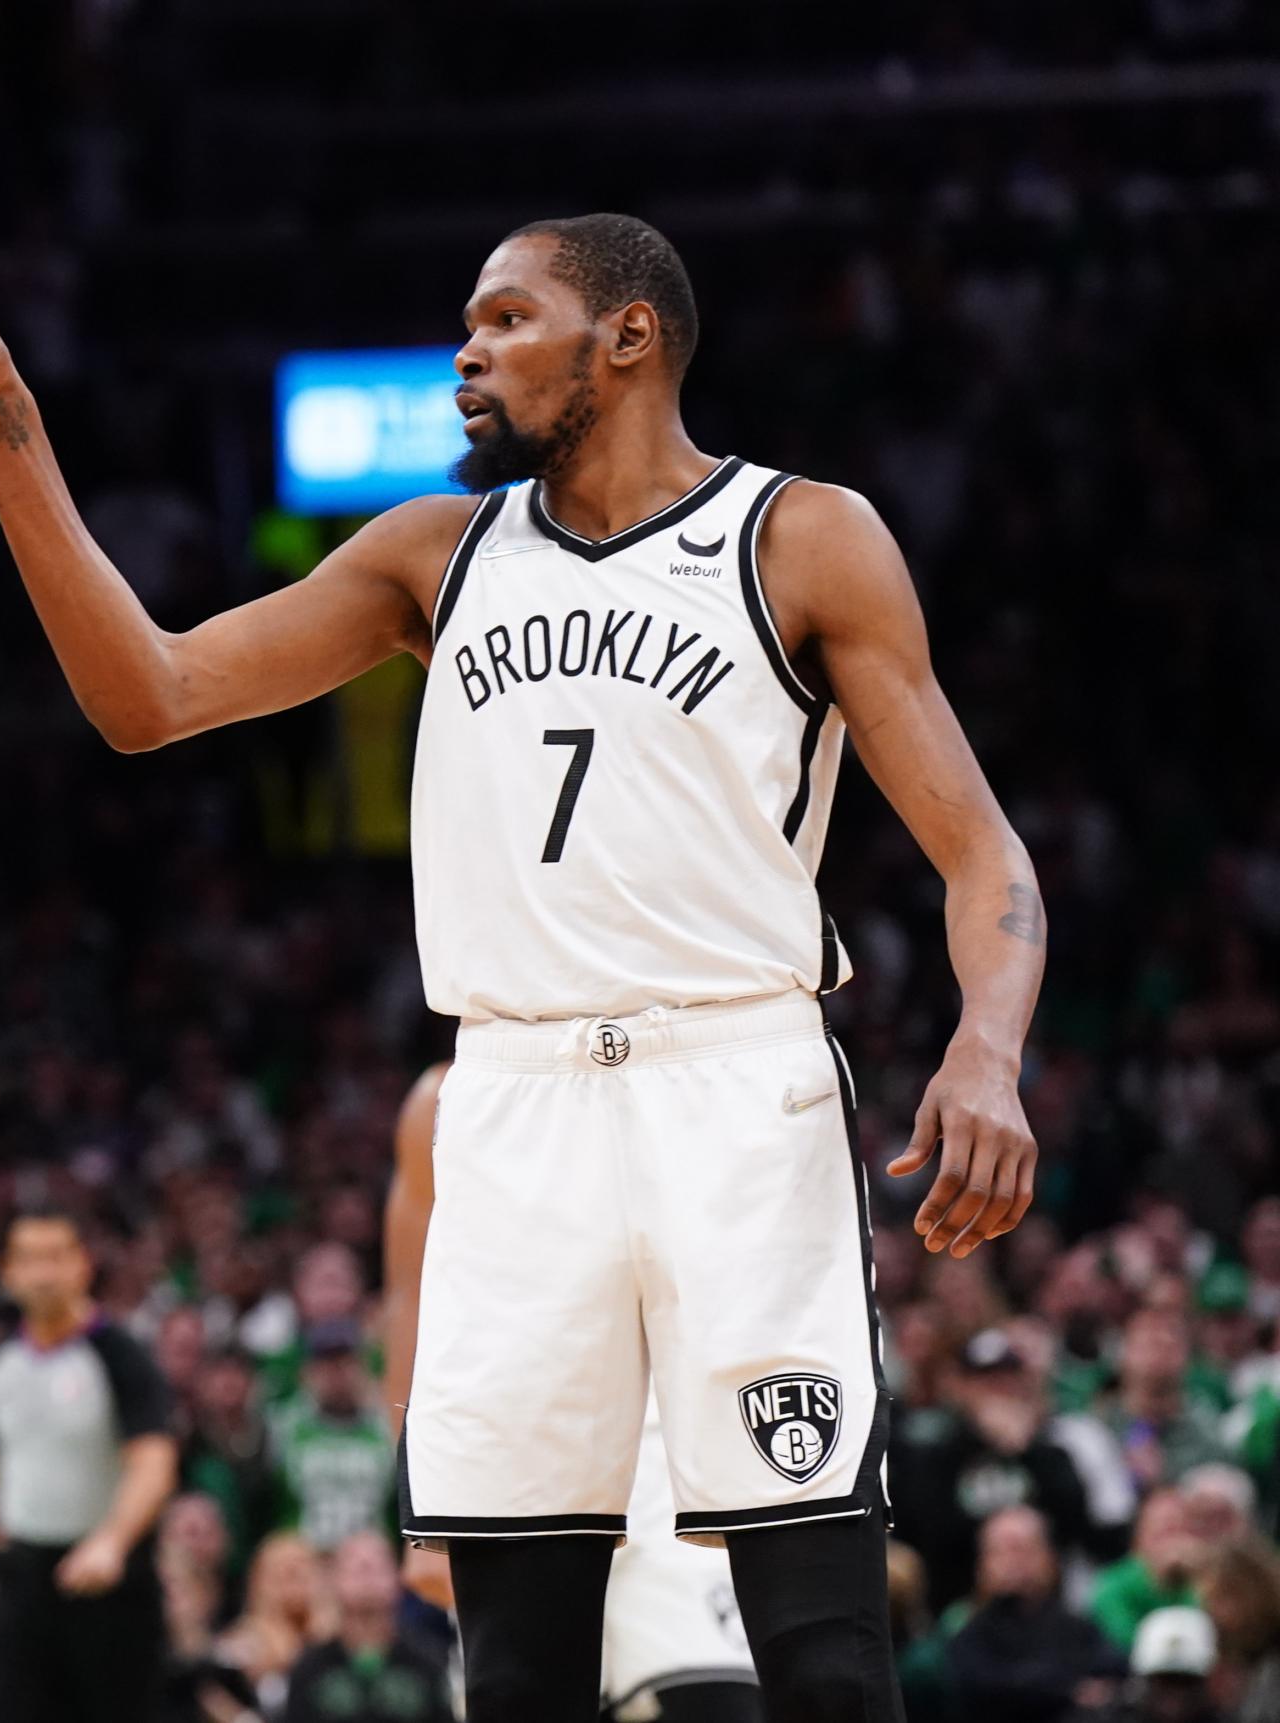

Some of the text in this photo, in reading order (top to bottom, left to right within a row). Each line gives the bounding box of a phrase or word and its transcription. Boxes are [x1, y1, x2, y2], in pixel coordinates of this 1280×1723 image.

[669, 562, 722, 579] Webull
[455, 609, 735, 716] BROOKLYN
[541, 728, 595, 863] 7
[602, 1031, 617, 1060] B
[747, 1380, 838, 1430] NETS
[789, 1428, 806, 1464] B
